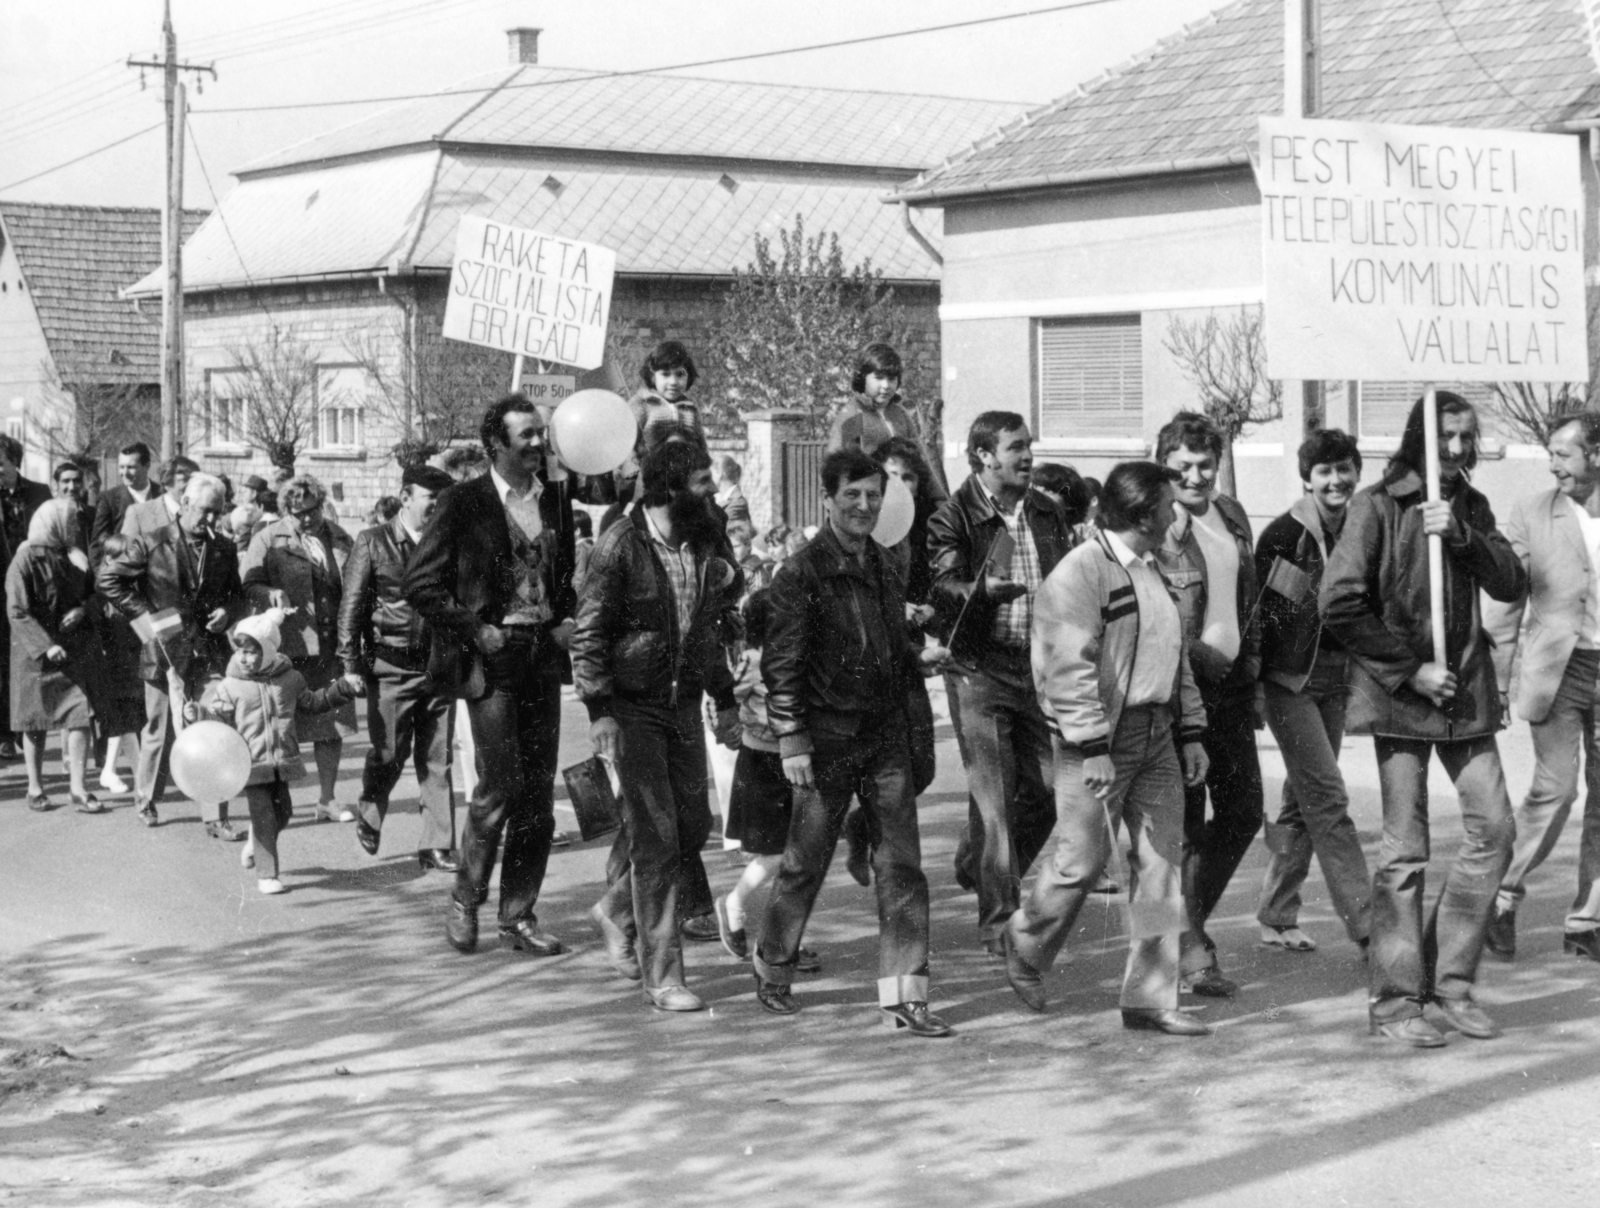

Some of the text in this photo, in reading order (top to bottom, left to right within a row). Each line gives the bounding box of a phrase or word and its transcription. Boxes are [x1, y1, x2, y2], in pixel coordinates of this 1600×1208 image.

[1271, 135, 1518, 194] PEST MEGYEI
[455, 259, 602, 328] SZOCIALISTA
[1330, 257, 1561, 309] KOMMUNÁLIS
[1397, 315, 1566, 365] VÁLLALAT
[522, 383, 547, 398] STOP
